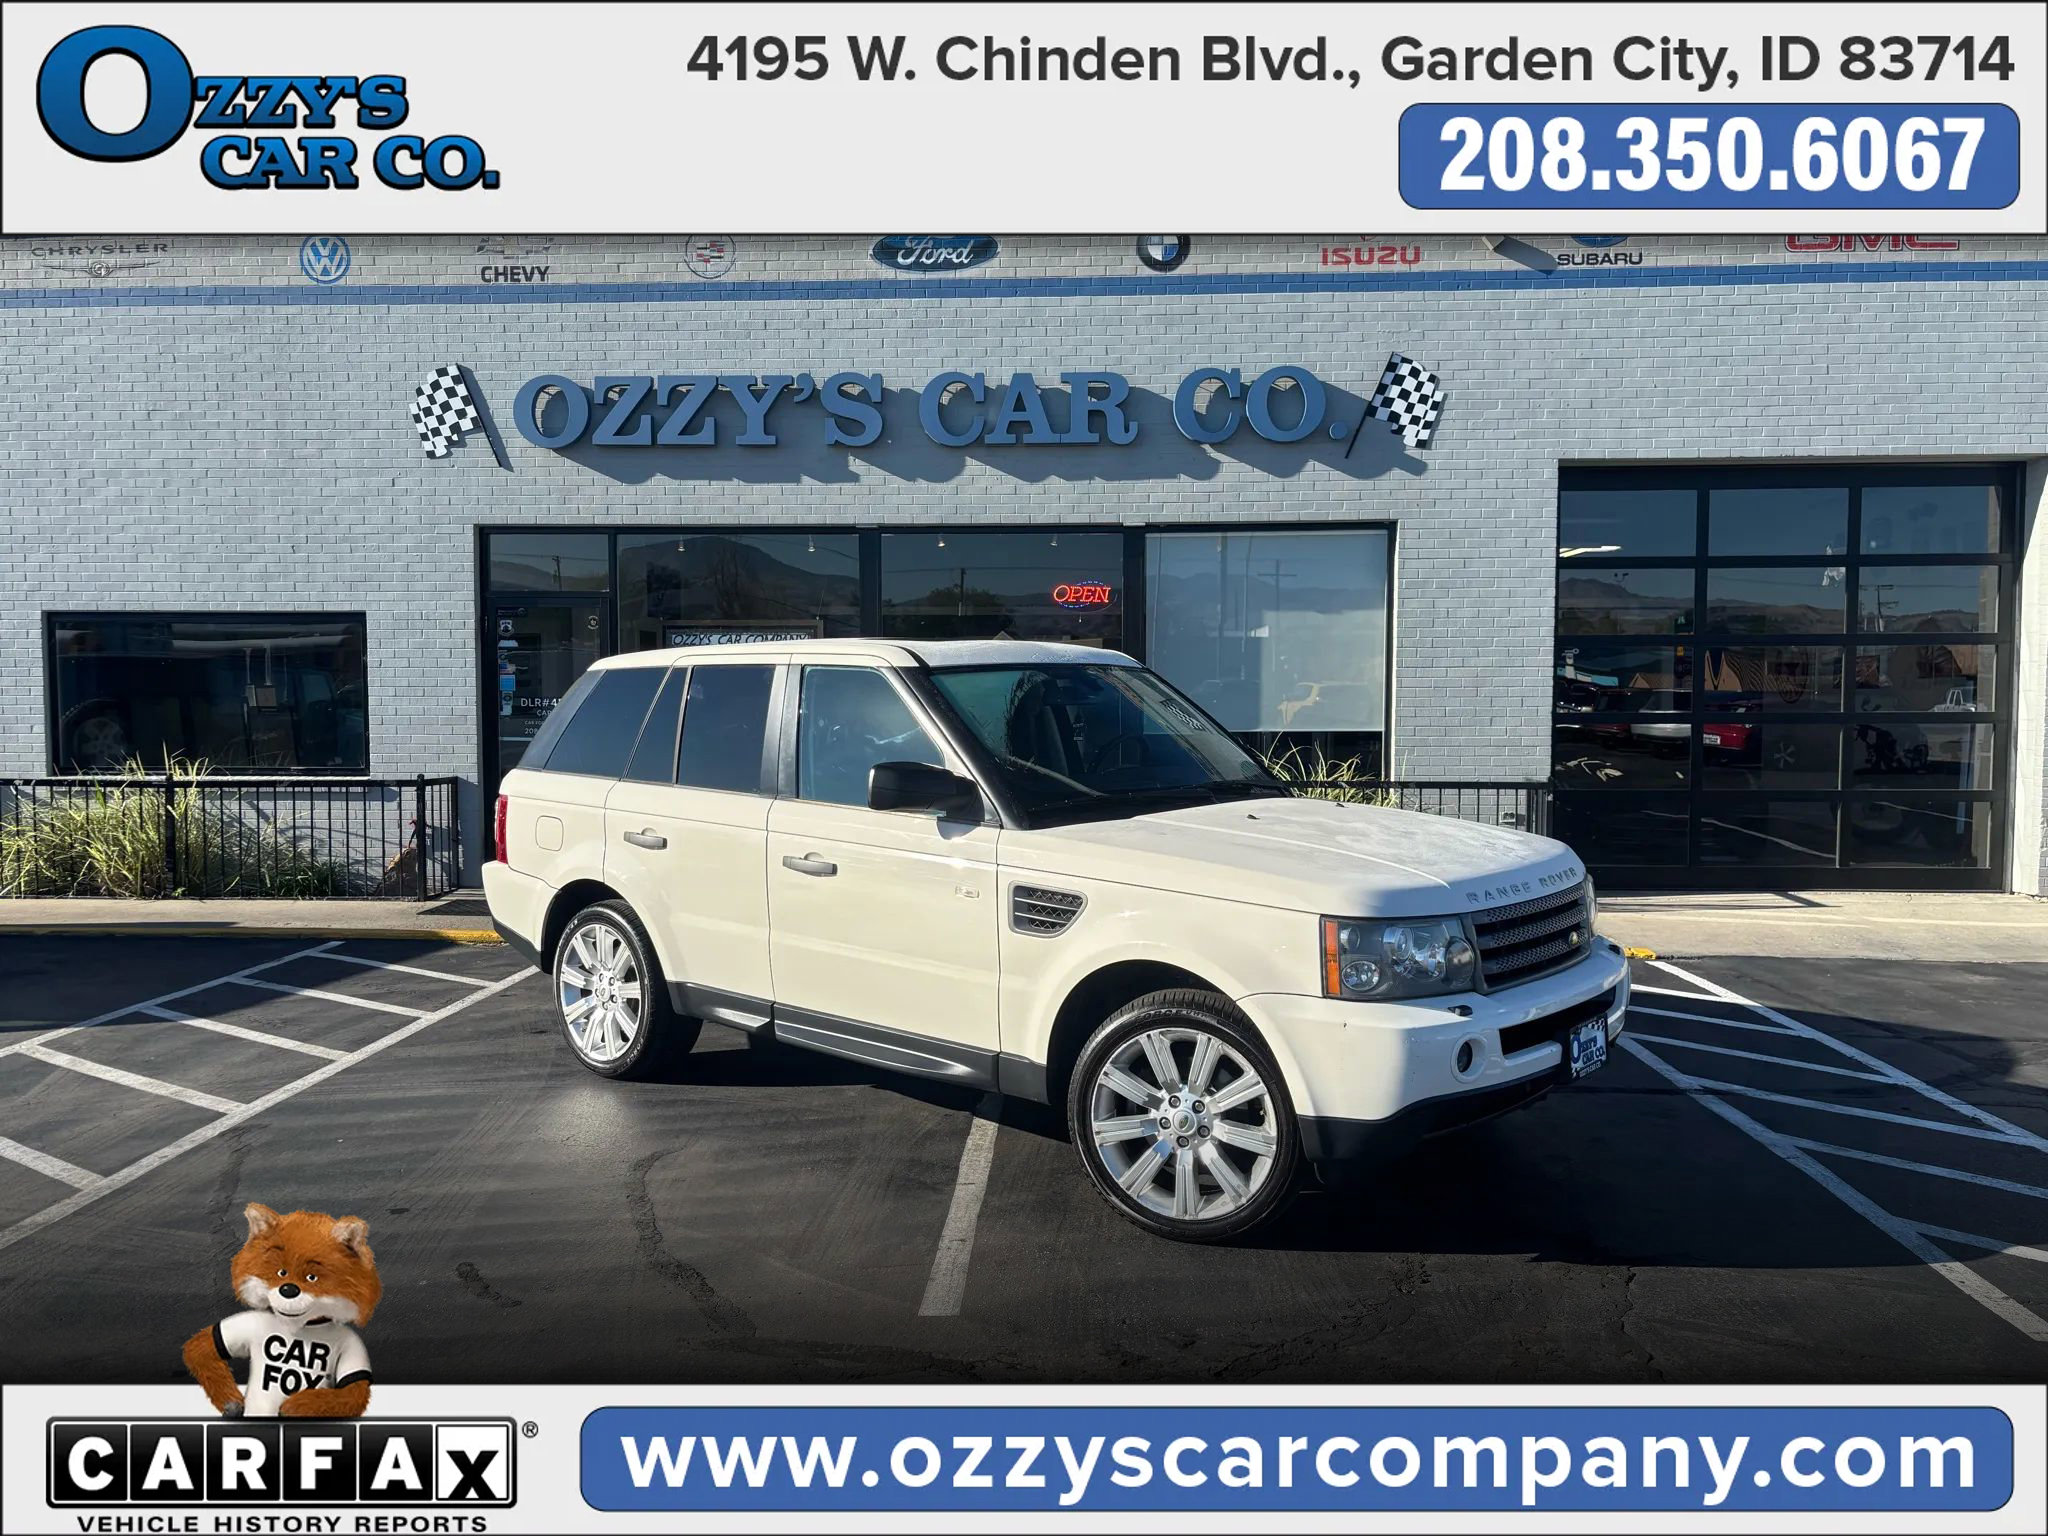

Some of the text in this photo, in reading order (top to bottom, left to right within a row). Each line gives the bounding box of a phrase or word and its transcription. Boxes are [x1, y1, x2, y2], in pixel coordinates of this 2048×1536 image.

[31, 243, 168, 257] CHRYSLER
[897, 235, 974, 265] Ford
[1321, 245, 1421, 266] ISUZU
[1557, 252, 1643, 266] SUBARU
[480, 265, 550, 283] CHEVY
[513, 366, 1348, 447] OZZY'S CAR CO.
[1053, 585, 1111, 603] OPEN
[673, 633, 712, 646] OZZY'S
[718, 633, 742, 645] CAR
[1465, 866, 1578, 905] RANGE ROVER
